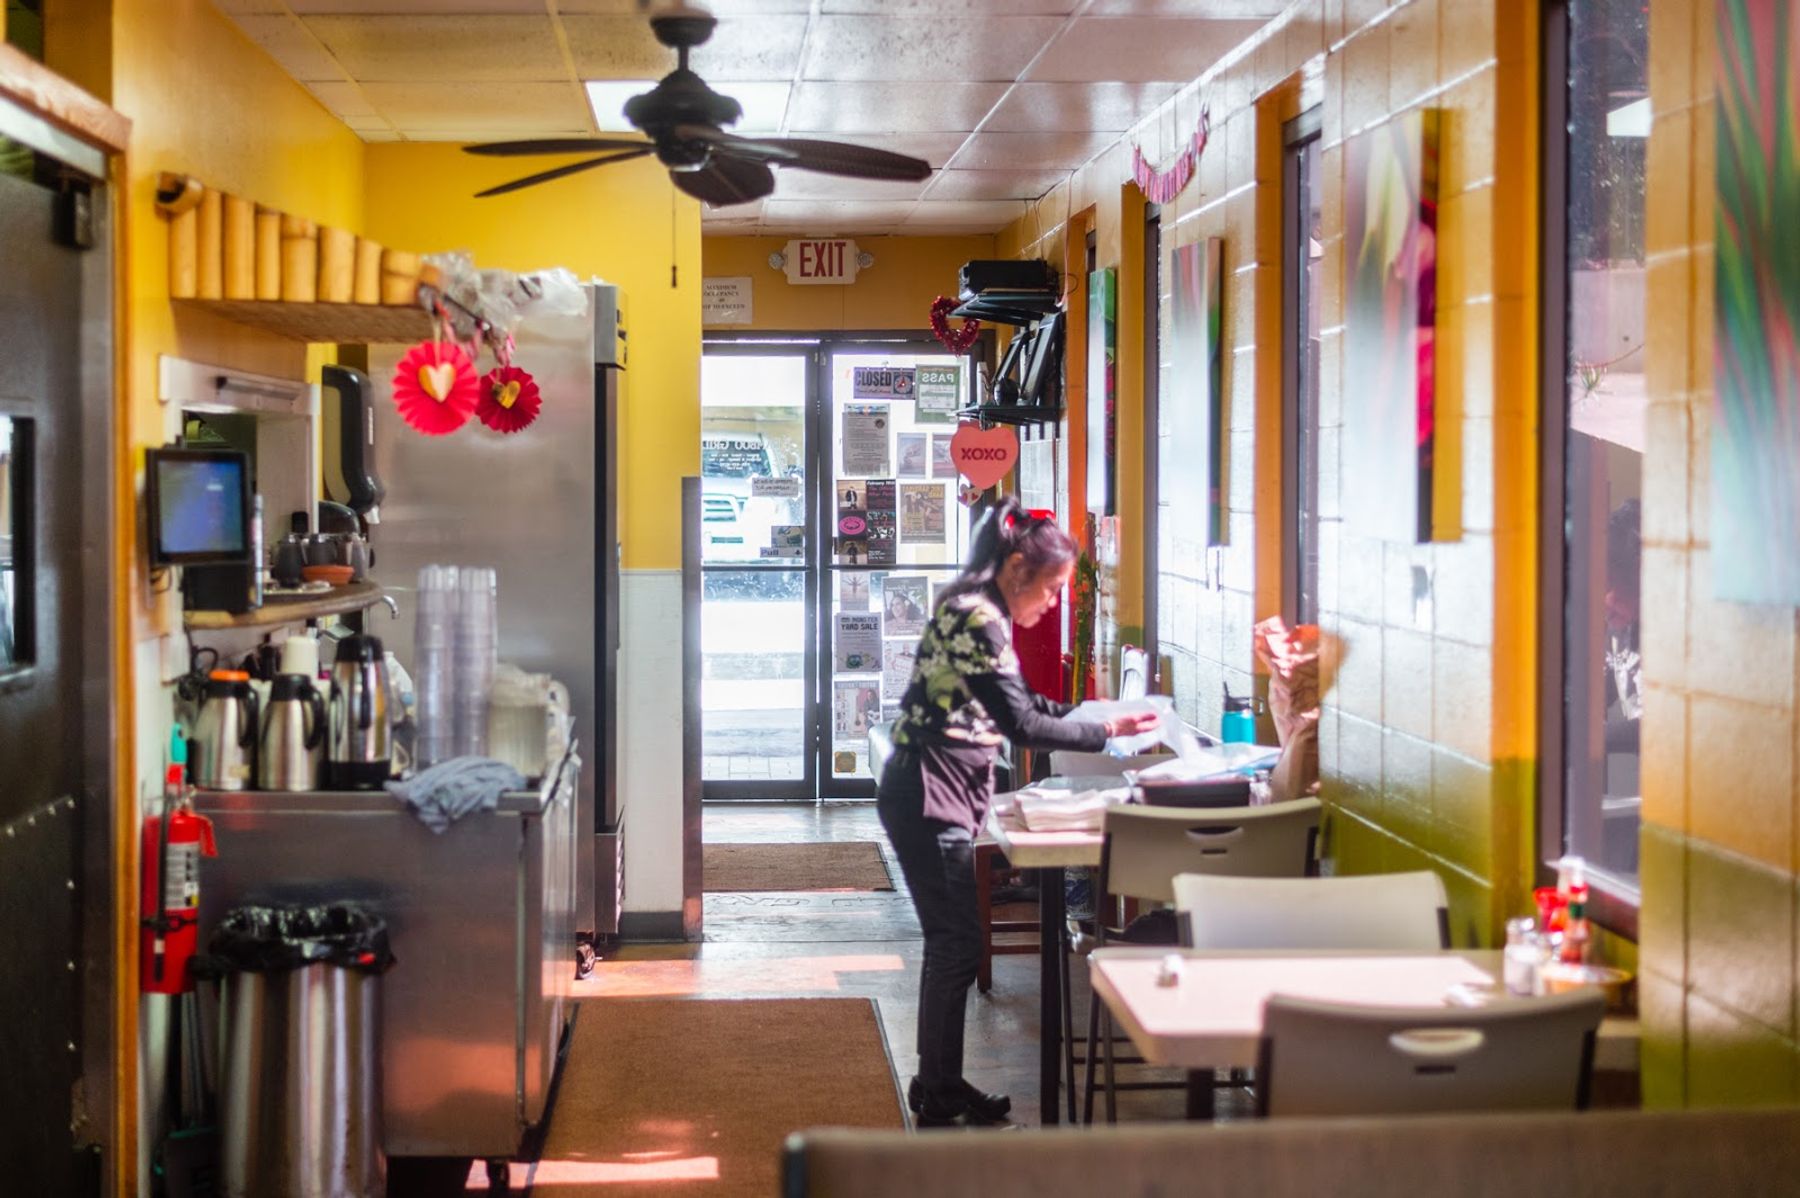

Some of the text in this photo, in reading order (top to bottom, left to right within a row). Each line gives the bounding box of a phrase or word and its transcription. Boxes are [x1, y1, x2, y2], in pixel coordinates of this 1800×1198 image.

[800, 242, 846, 277] EXIT
[855, 371, 892, 387] CLOSED
[961, 447, 1007, 461] XOXO
[841, 623, 878, 631] YARD SALE
